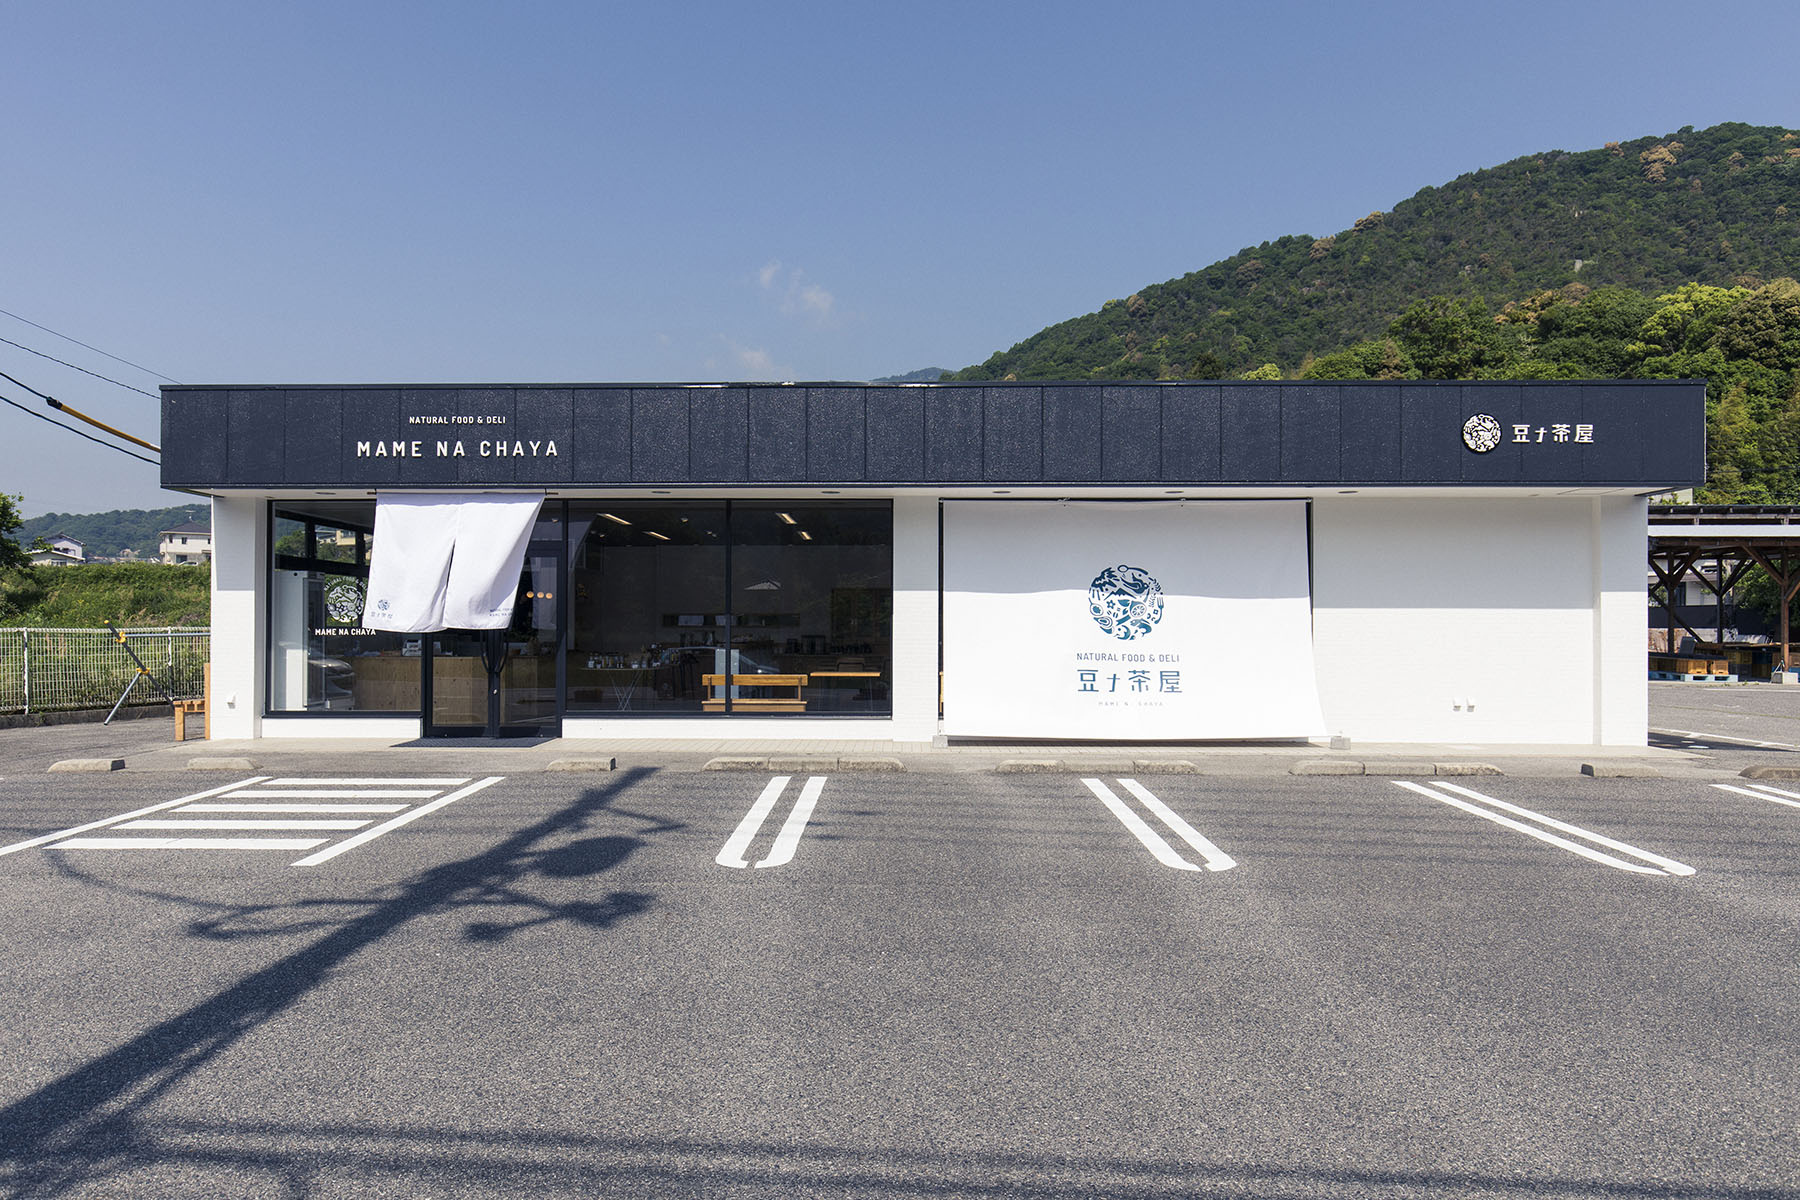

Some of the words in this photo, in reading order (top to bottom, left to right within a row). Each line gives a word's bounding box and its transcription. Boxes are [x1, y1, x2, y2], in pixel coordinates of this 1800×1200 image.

[409, 416, 449, 424] NATURAL
[451, 416, 474, 424] FOOD
[477, 416, 484, 424] &
[486, 416, 506, 424] DELI
[357, 440, 423, 457] MAME
[436, 440, 465, 457] NA
[480, 440, 558, 457] CHAYA
[314, 628, 336, 636] MAME
[338, 628, 349, 636] NA
[350, 628, 376, 636] CHAYA
[1076, 652, 1118, 662] NATURAL
[1121, 653, 1145, 662] FOOD
[1149, 654, 1156, 662] &
[1159, 654, 1180, 663] DELI
